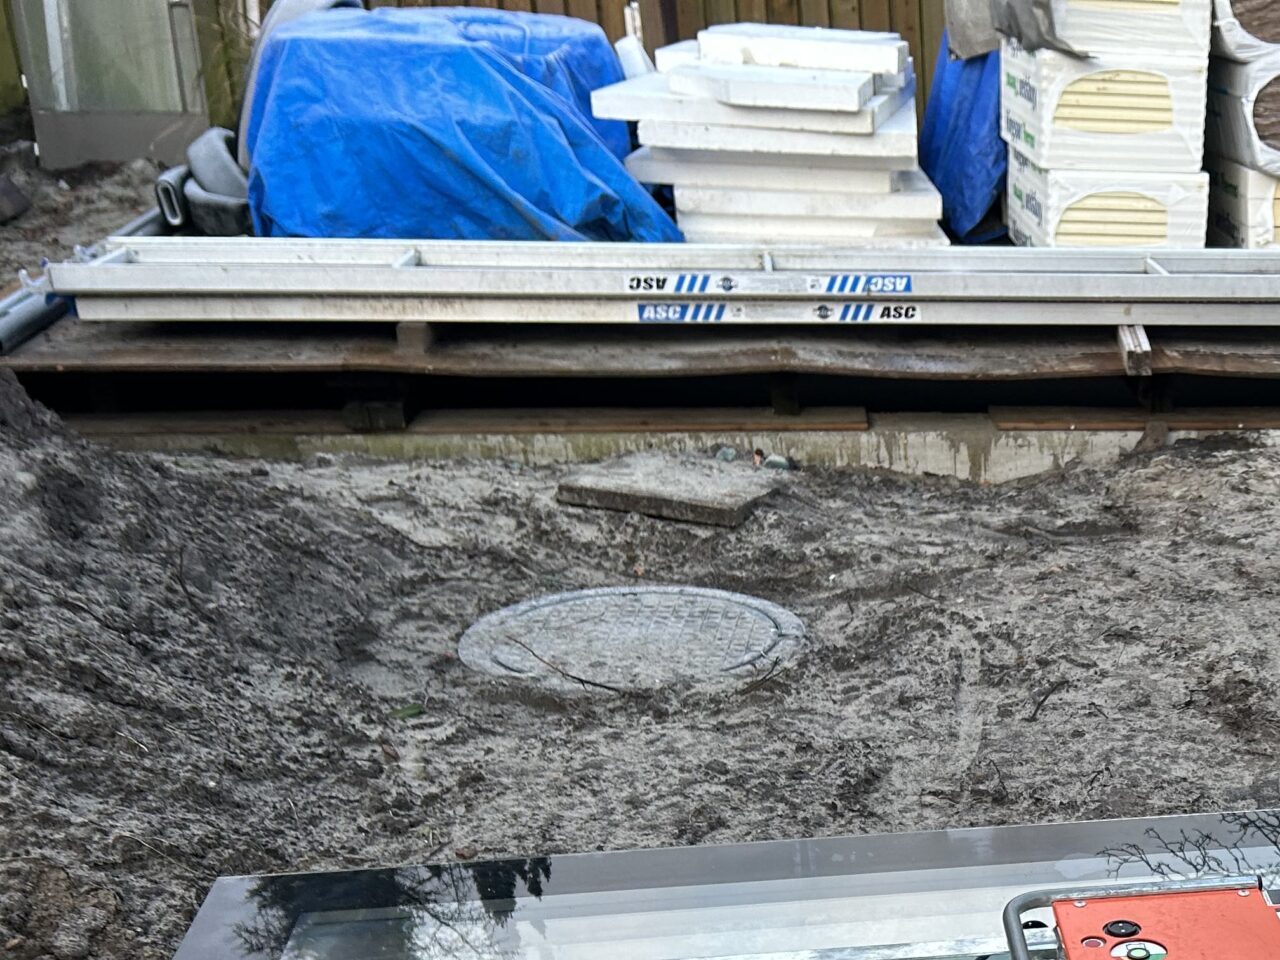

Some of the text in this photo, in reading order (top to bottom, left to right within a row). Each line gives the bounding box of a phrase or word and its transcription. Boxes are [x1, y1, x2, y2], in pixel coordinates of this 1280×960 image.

[628, 275, 667, 291] ASC
[869, 276, 908, 292] ASC
[642, 304, 683, 320] ASC
[879, 304, 917, 319] ASC
